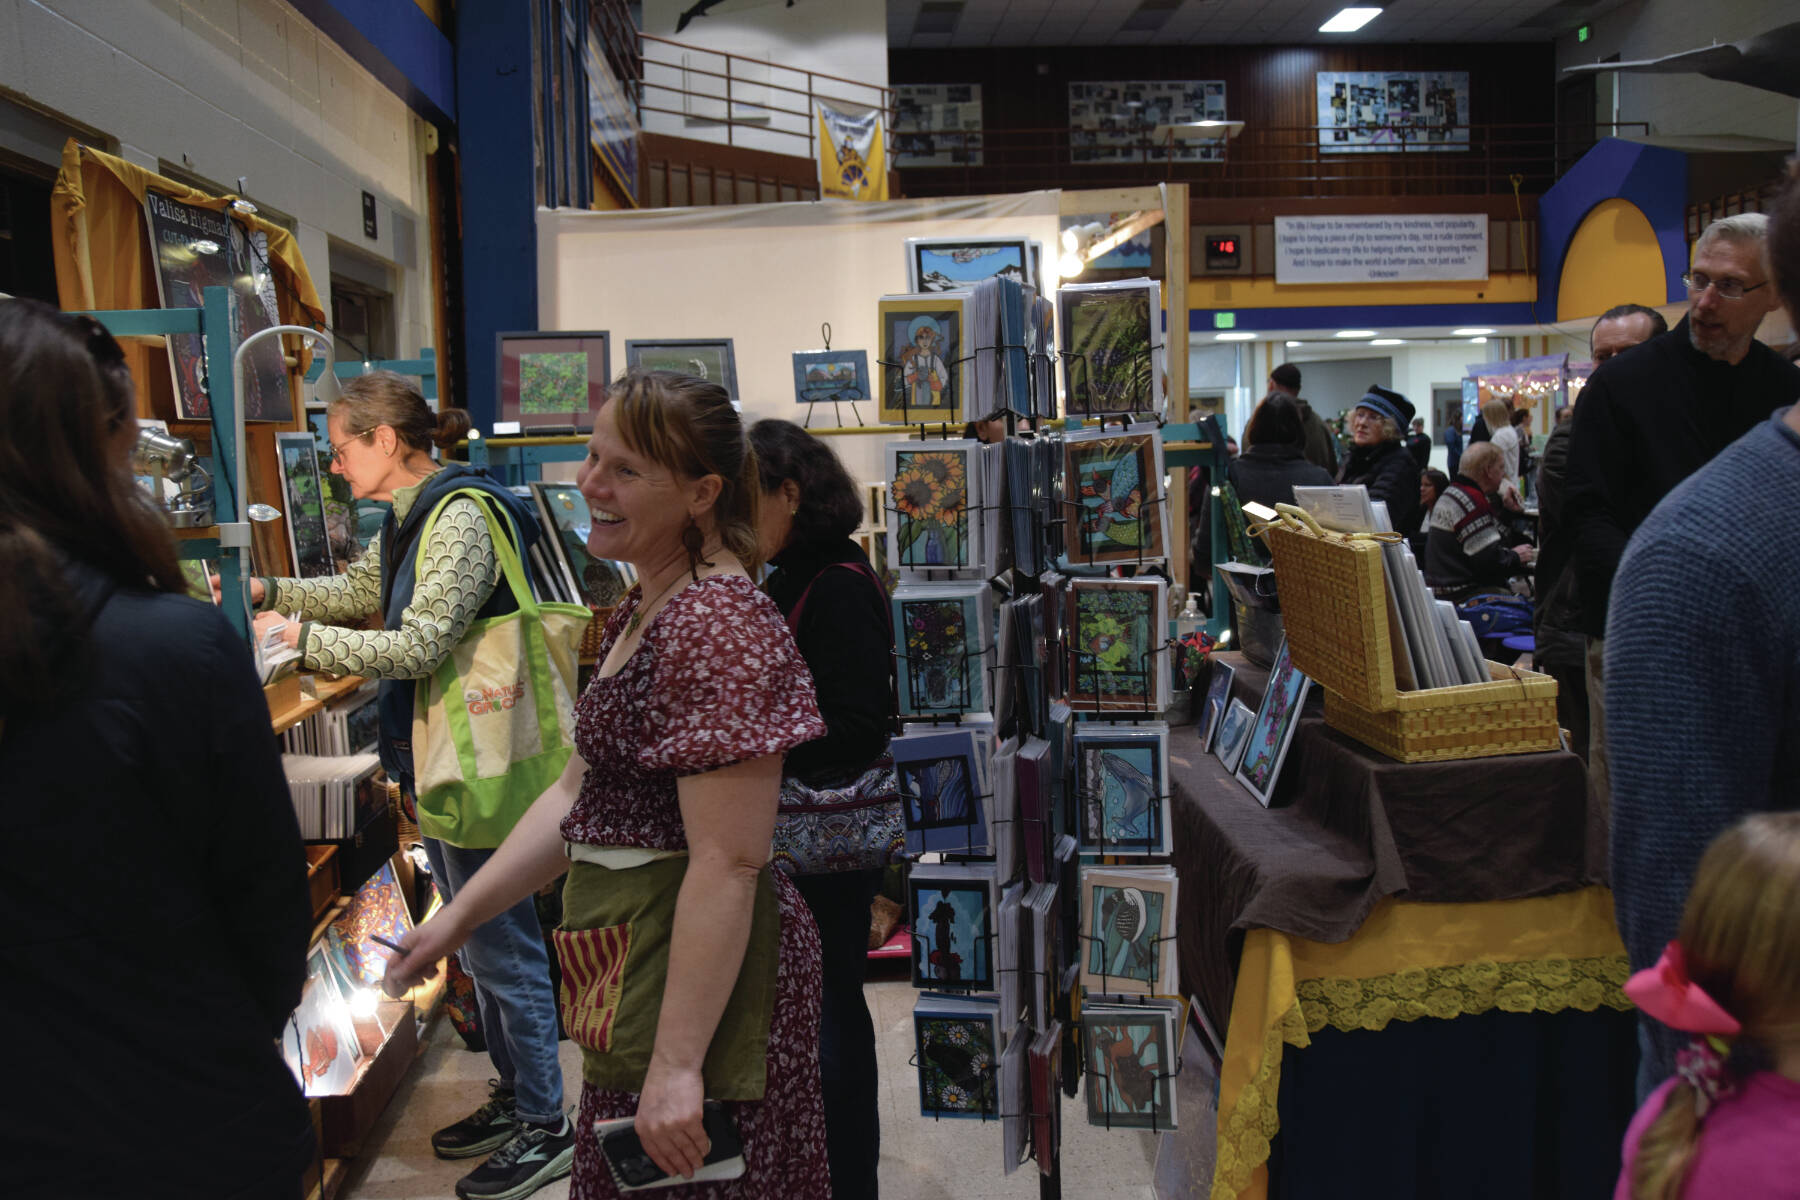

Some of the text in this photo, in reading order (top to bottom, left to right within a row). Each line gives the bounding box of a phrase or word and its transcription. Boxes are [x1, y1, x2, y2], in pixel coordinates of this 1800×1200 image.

[147, 193, 189, 224] Valisa
[1310, 222, 1325, 231] hope
[1344, 221, 1383, 229] remembered
[1393, 222, 1402, 230] my
[1282, 235, 1297, 243] hope
[1307, 234, 1323, 244] bring
[1355, 234, 1365, 244] joy
[1422, 233, 1432, 241] not
[1440, 233, 1453, 241] rude
[1288, 247, 1304, 256] hope
[1341, 248, 1351, 256] my
[1352, 246, 1362, 254] life
[1370, 246, 1394, 255] helping
[1436, 246, 1460, 254] ignoring
[1292, 259, 1305, 267] And
[1310, 259, 1325, 268] hope
[1335, 258, 1351, 266] make
[1353, 258, 1362, 266] the
[1364, 258, 1381, 266] world
[1438, 258, 1450, 266] just
